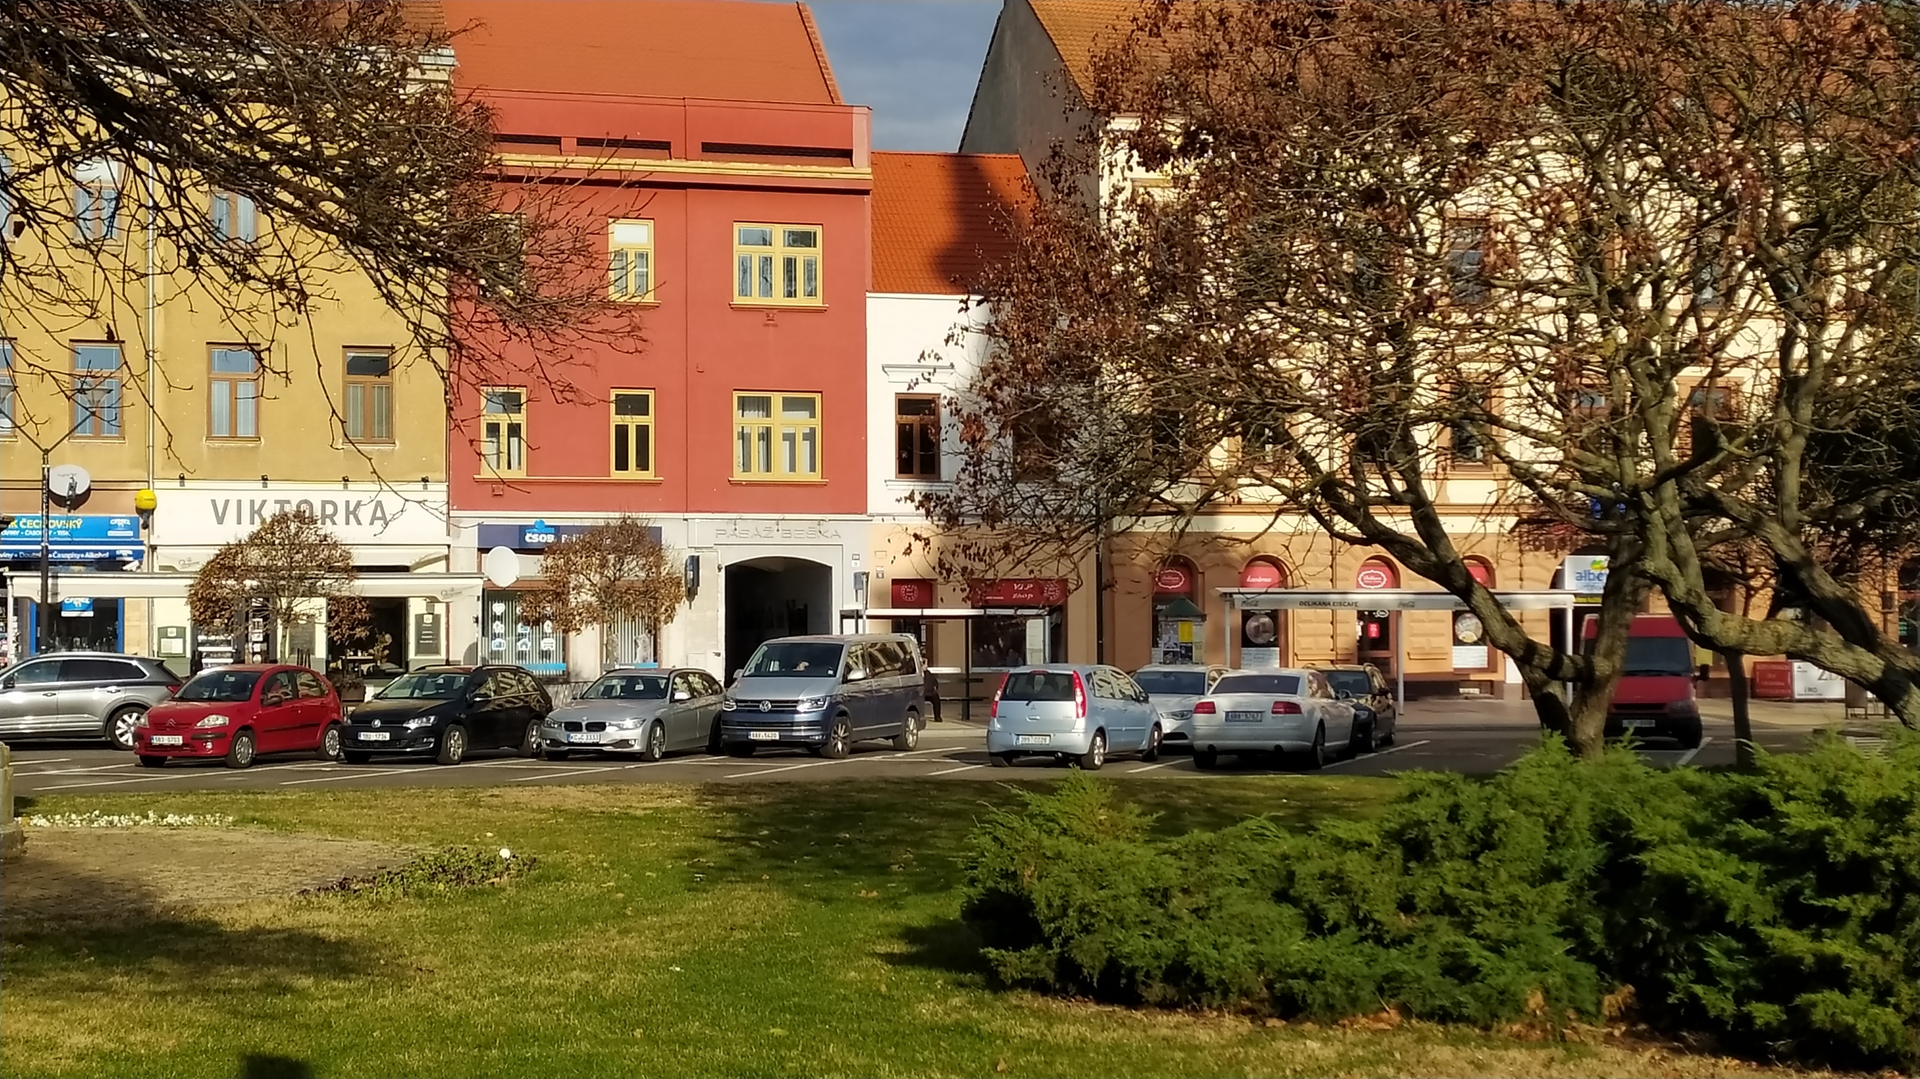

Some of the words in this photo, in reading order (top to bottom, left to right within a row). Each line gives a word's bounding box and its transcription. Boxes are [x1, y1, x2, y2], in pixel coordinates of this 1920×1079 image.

[211, 499, 388, 526] VIKTORKA
[20, 518, 83, 529] ČECOVSKÝ
[525, 532, 555, 543] ČSOB
[1575, 570, 1606, 582] albe
